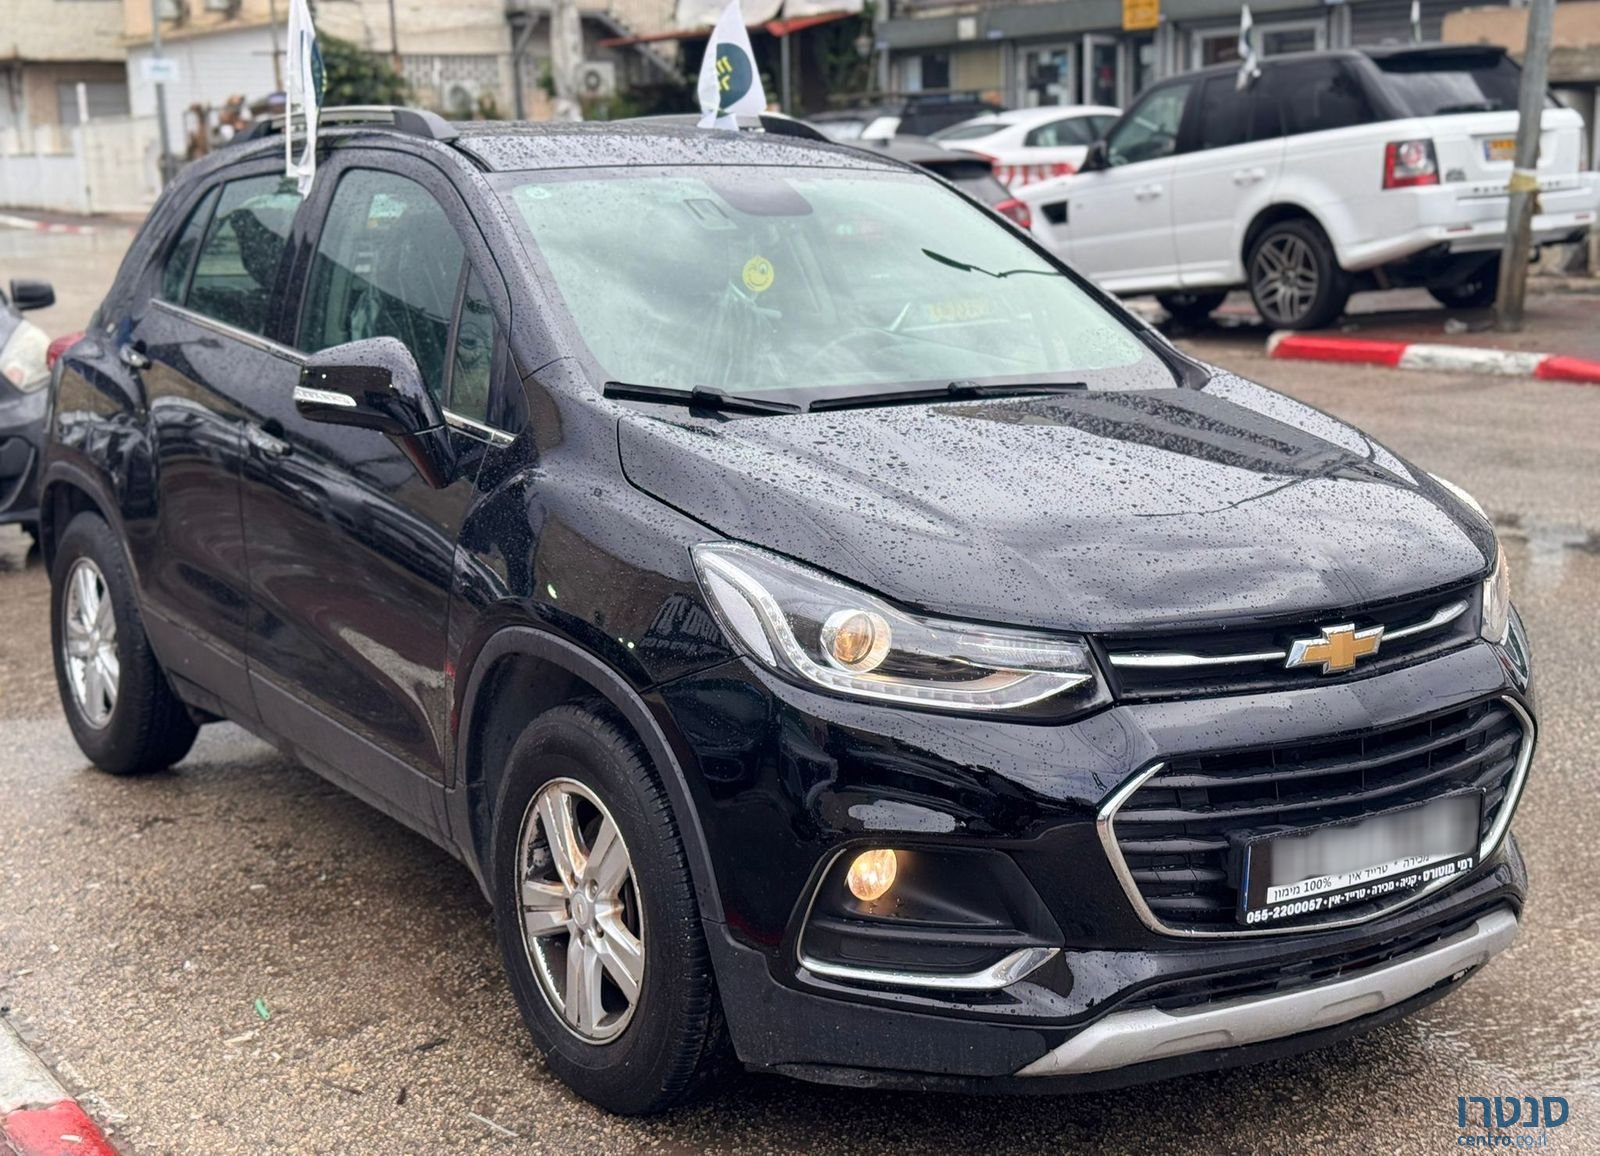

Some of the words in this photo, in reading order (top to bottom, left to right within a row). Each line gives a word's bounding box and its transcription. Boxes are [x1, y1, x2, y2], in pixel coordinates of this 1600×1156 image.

[1457, 857, 1473, 871] רמי
[1348, 871, 1362, 884] אין
[1365, 865, 1389, 878] טרייד
[1423, 863, 1456, 882] מוטורס
[1304, 876, 1332, 893] 100%
[1372, 881, 1395, 895] מכירה
[1400, 875, 1417, 888] קניה
[1274, 886, 1301, 901] מימון
